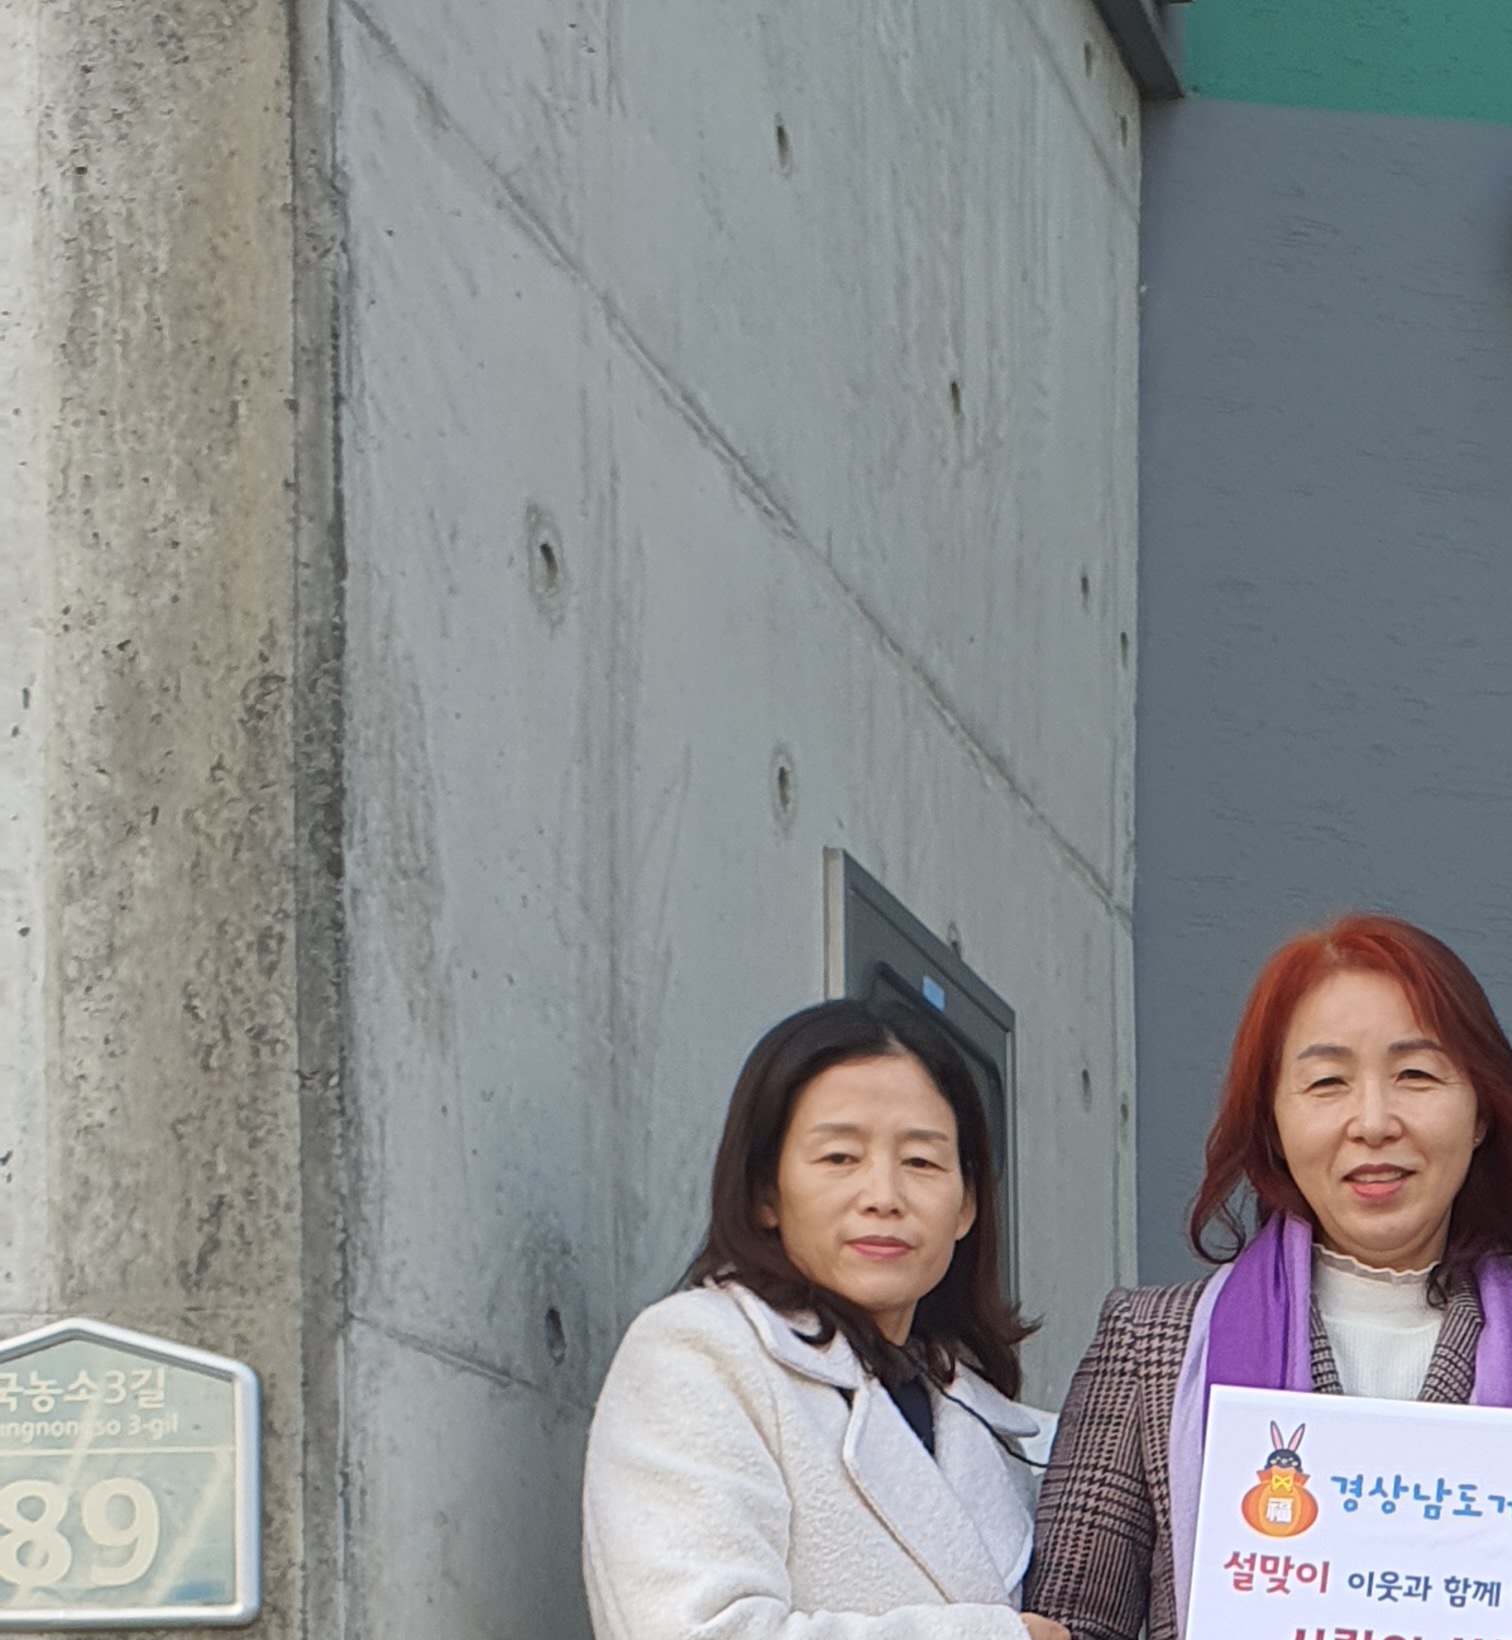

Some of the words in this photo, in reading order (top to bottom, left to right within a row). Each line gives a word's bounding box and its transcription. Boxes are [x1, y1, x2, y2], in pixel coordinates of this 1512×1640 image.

[0, 1477, 160, 1586] 89
[1223, 1551, 1331, 1596] 설맞이
[1347, 1571, 1433, 1603] 이웃과
[1444, 1575, 1503, 1609] 함께
